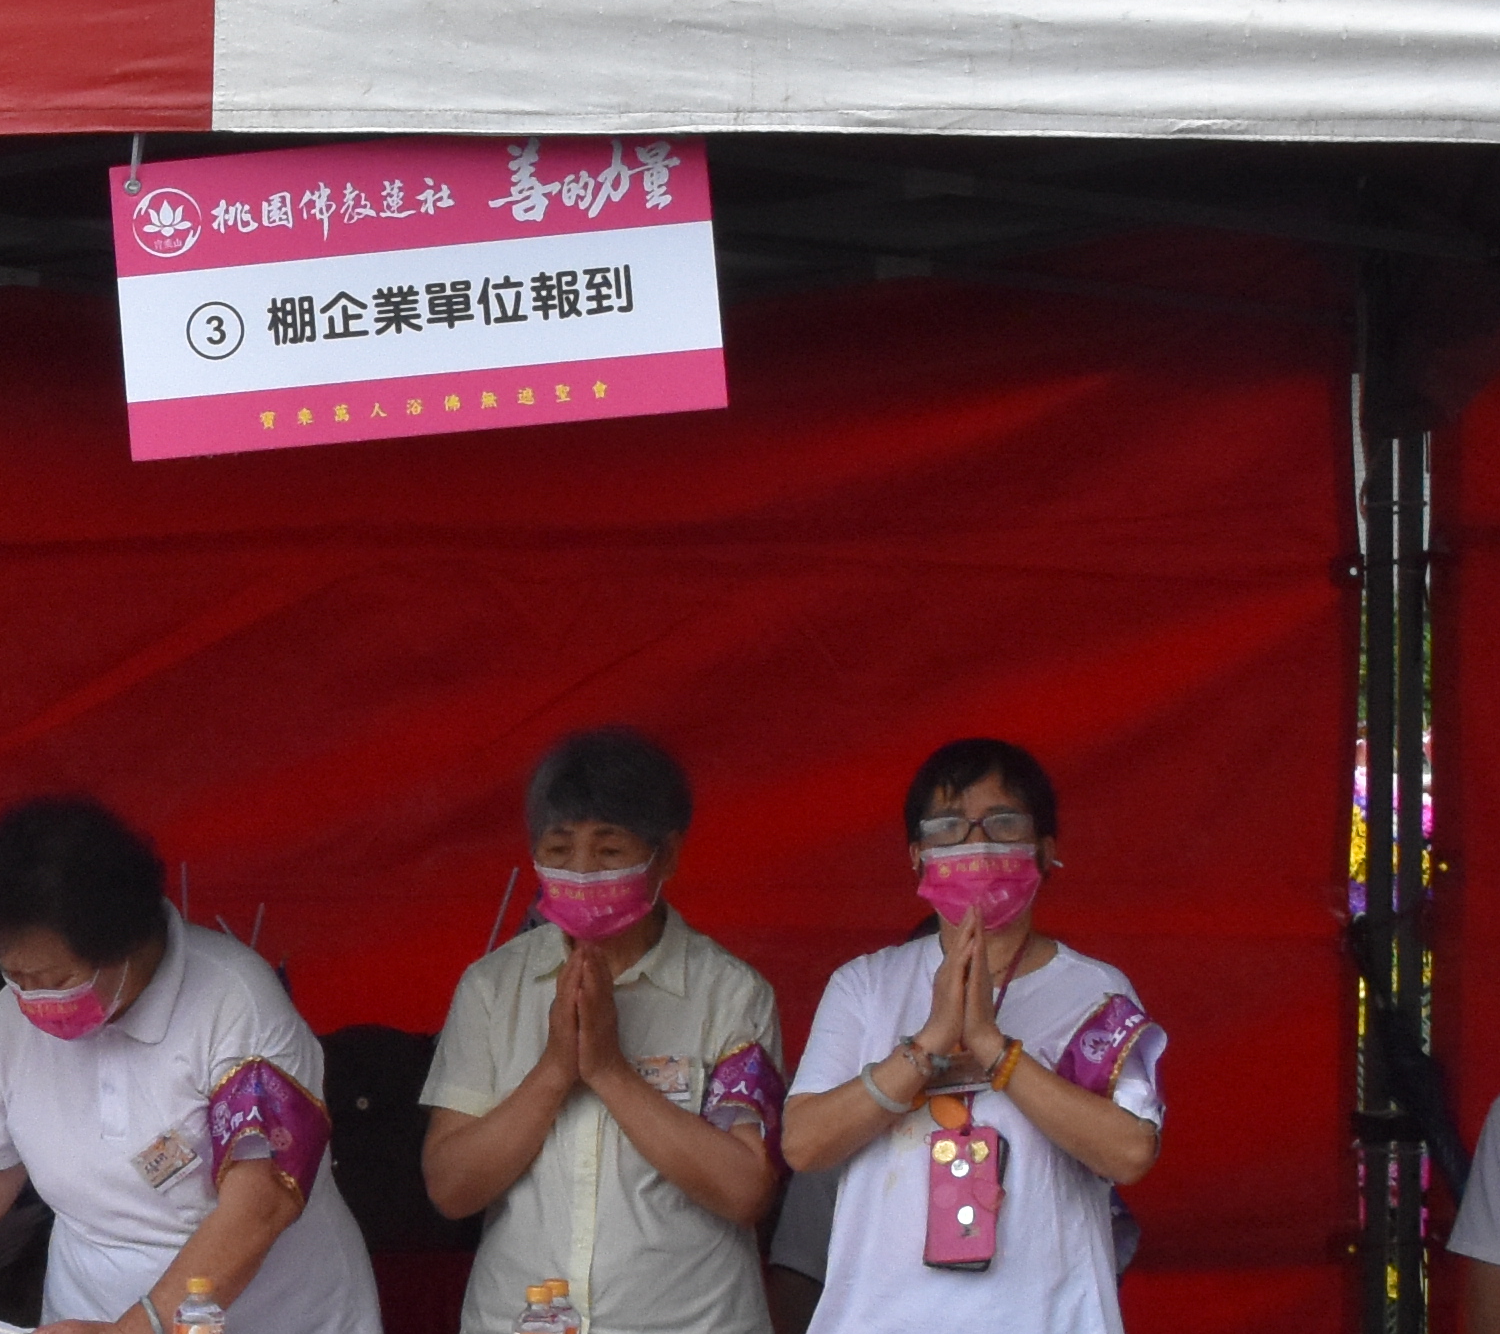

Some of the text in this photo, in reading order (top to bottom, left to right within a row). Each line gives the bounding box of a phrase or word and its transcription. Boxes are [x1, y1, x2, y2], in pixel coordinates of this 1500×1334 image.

[488, 140, 680, 223] 善的力量
[267, 264, 635, 347] 棚企業單位報到
